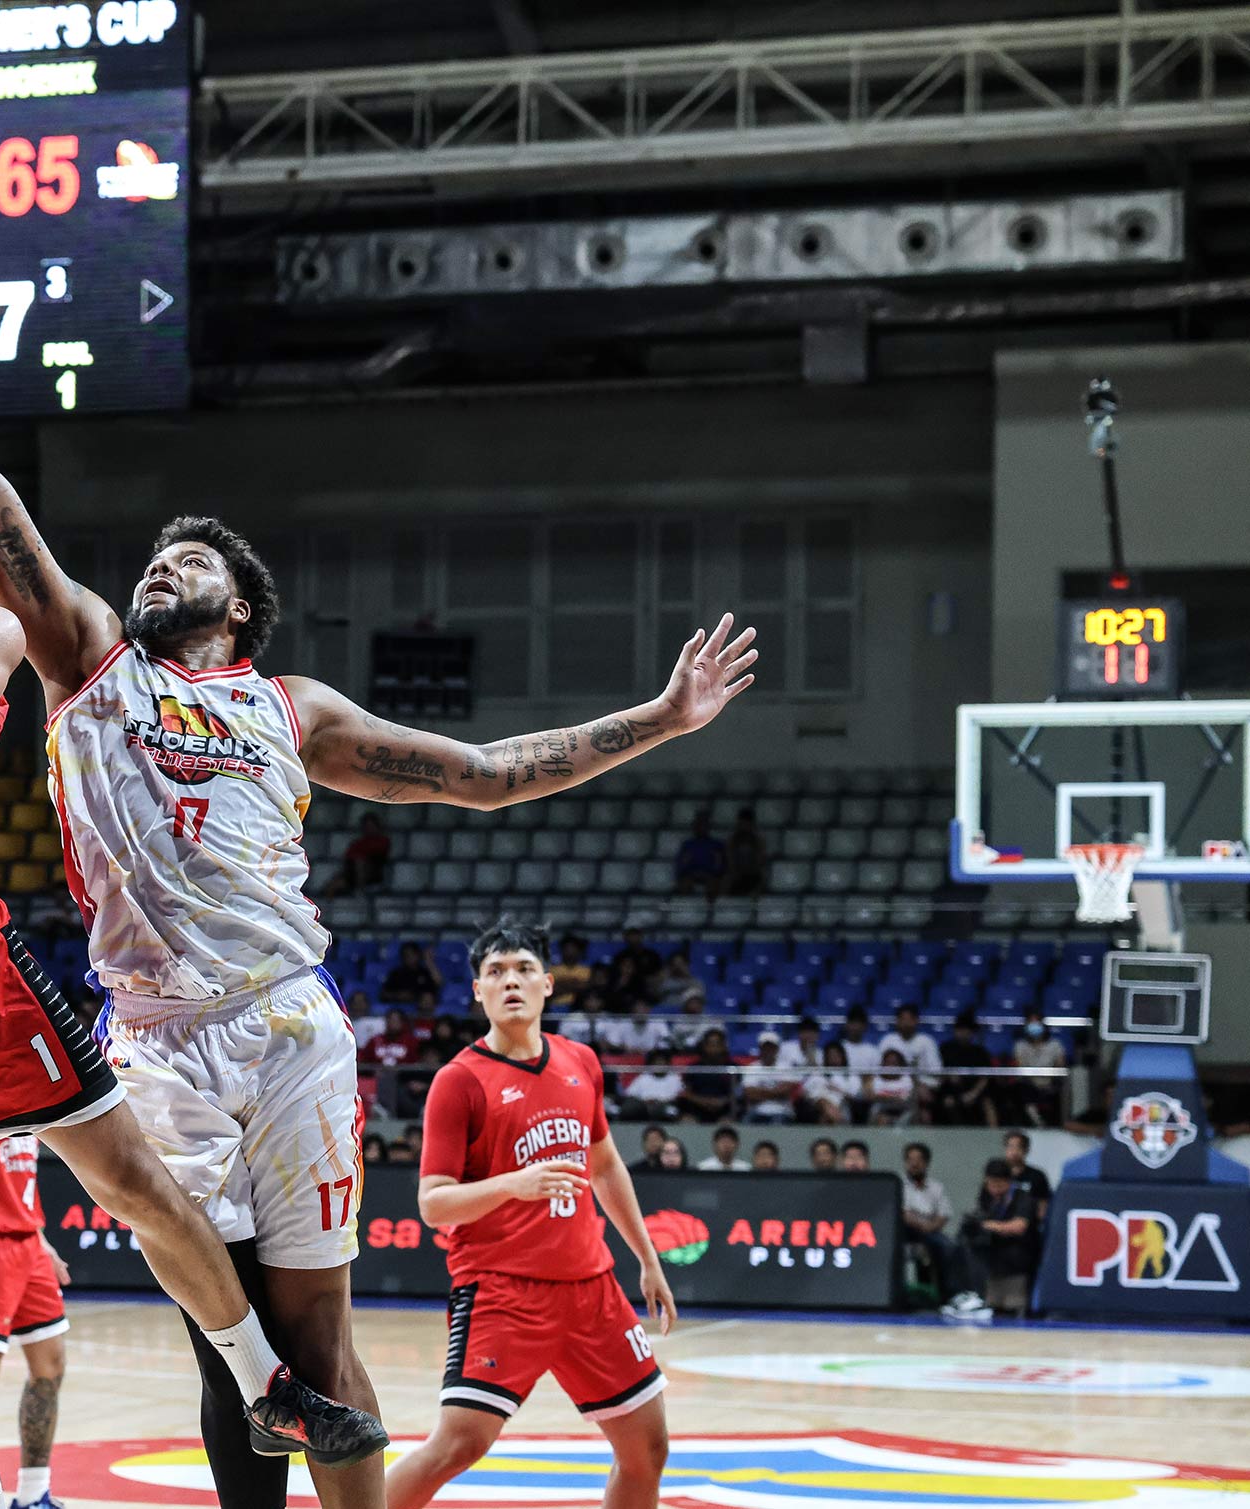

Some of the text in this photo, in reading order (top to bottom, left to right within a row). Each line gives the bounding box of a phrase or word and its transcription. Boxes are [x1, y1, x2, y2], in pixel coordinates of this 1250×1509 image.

[97, 0, 177, 46] CUP
[45, 265, 67, 299] 3
[56, 370, 76, 410] 1
[1104, 643, 1149, 684] 11
[174, 797, 209, 844] 17
[30, 1033, 61, 1082] 1
[514, 1118, 591, 1167] GINEBRA
[61, 1204, 131, 1230] AR
[317, 1175, 353, 1231] 17
[726, 1218, 877, 1248] ARENA
[1067, 1208, 1240, 1292] PBA
[749, 1246, 852, 1269] PLUS
[624, 1323, 652, 1363] 18
